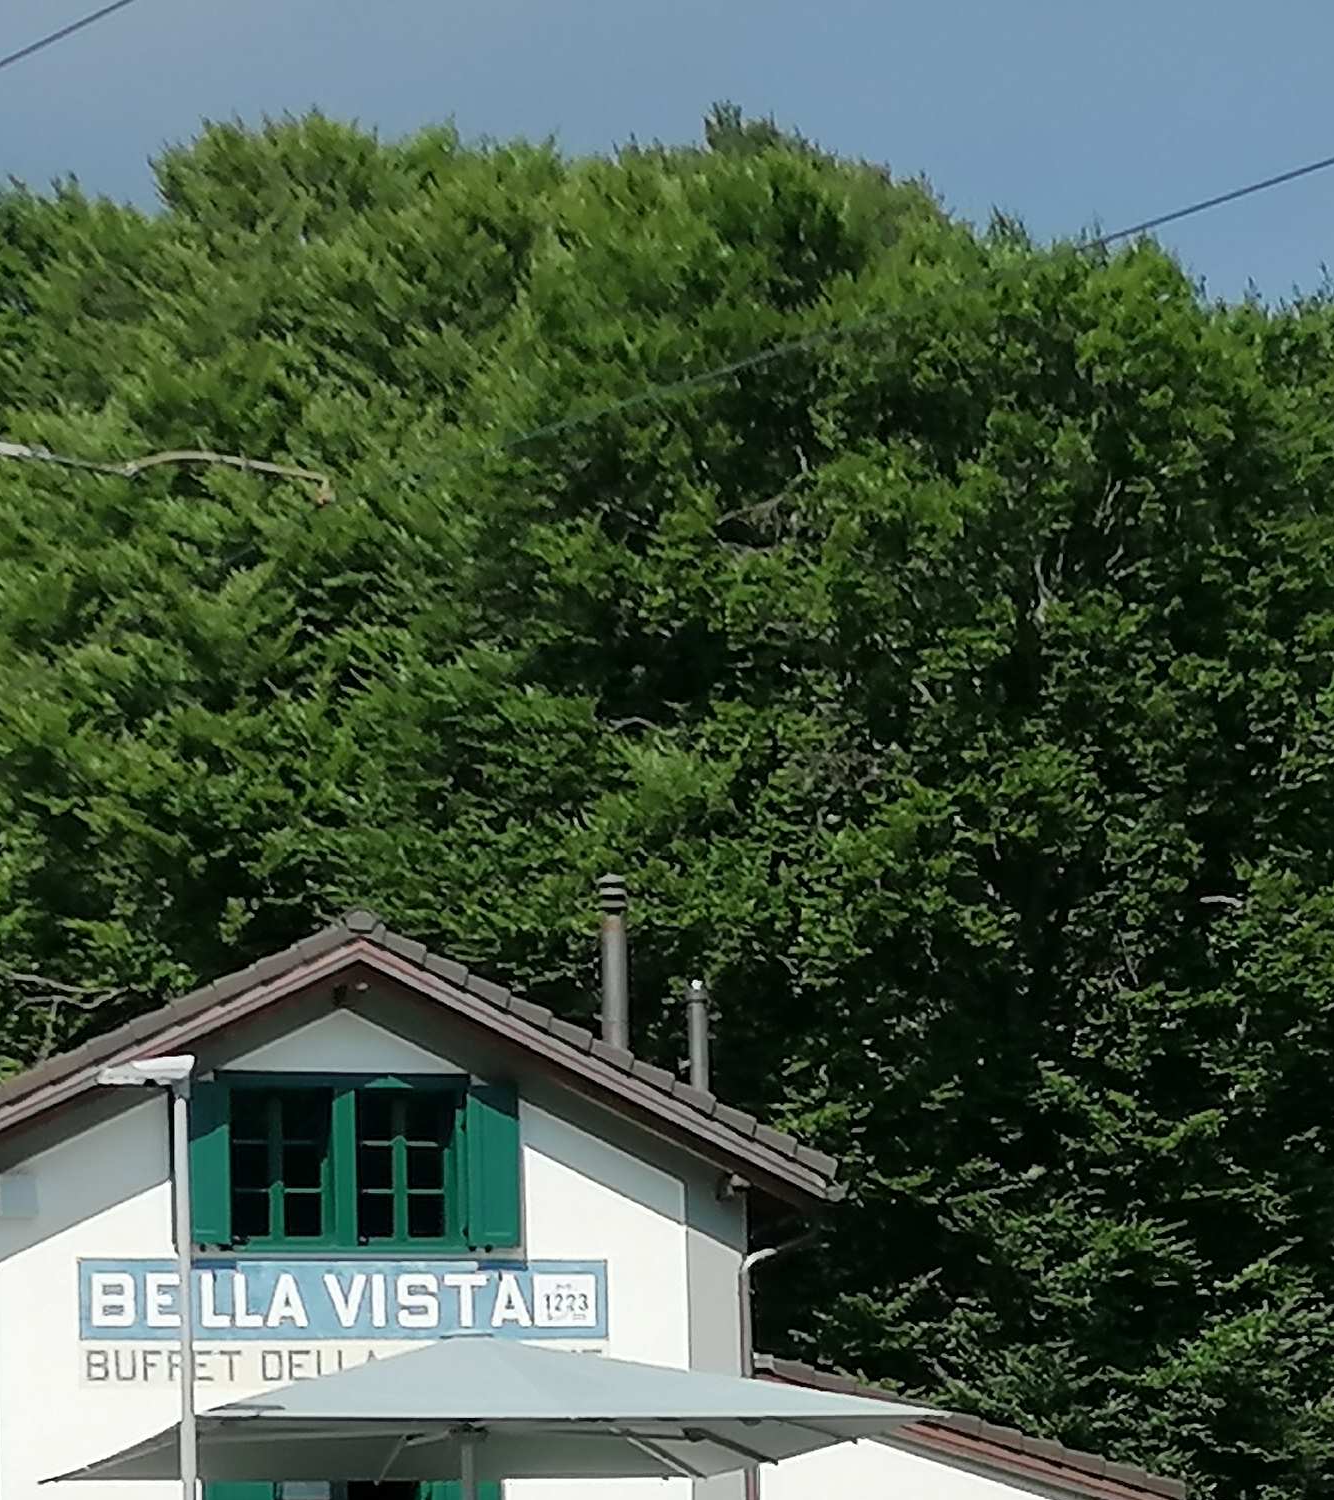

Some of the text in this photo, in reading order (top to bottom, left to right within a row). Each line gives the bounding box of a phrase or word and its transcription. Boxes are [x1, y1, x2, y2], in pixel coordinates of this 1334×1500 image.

[90, 1272, 534, 1328] BELLA VISTA
[86, 1349, 378, 1382] BUFFET DELL
